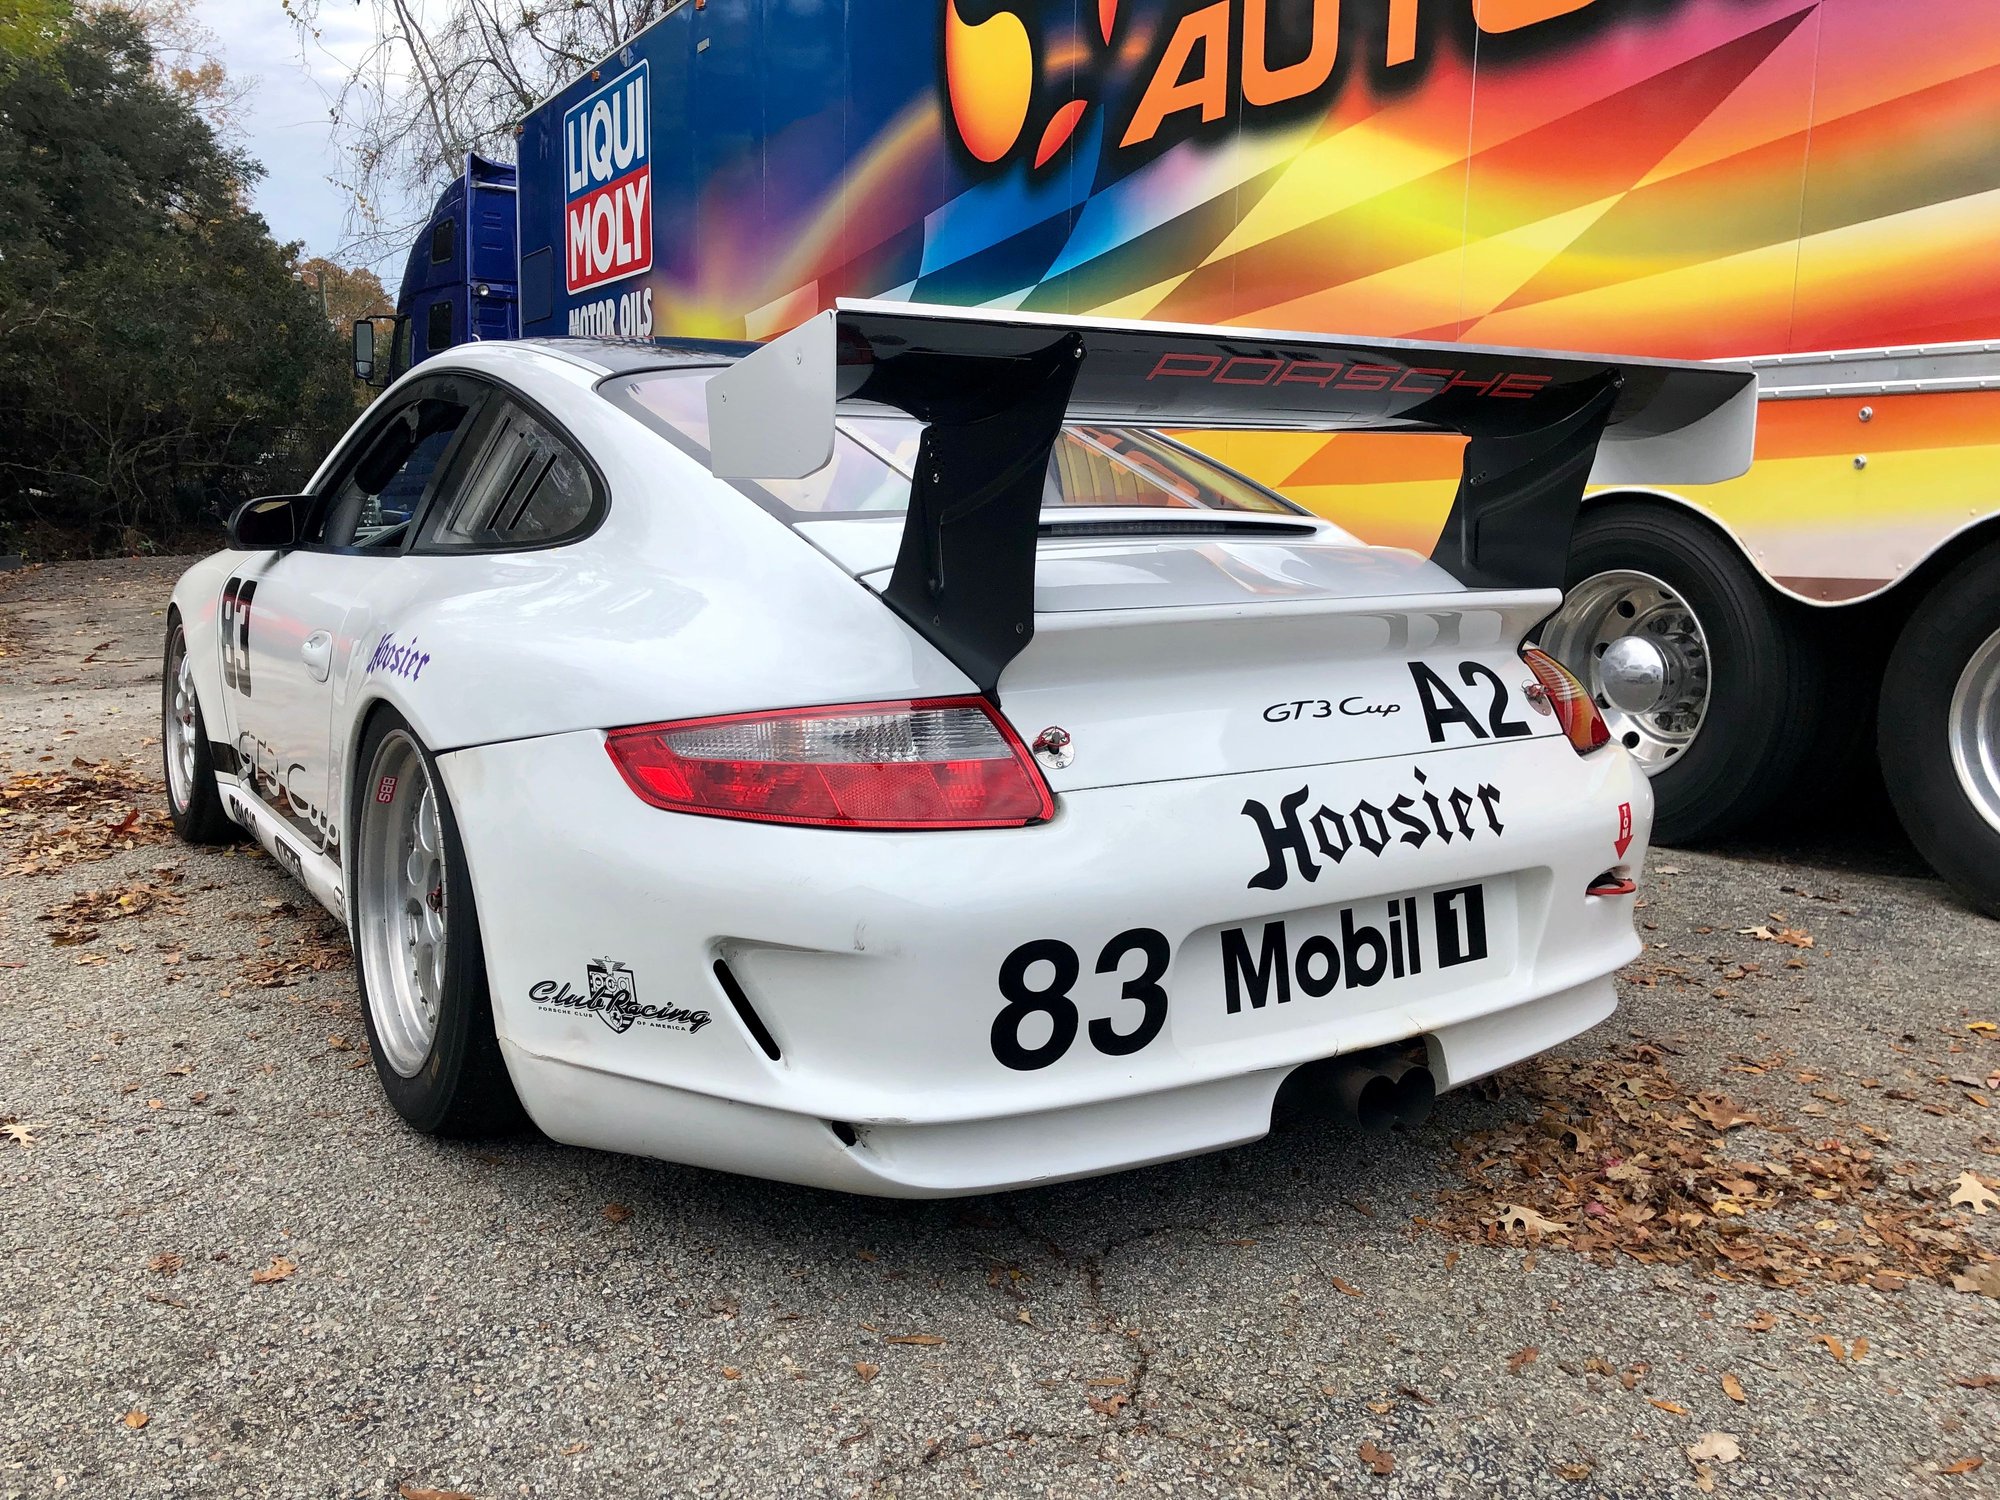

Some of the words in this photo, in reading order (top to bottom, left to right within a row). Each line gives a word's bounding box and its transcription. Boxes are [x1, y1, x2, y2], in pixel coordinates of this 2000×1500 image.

[567, 74, 645, 194] LIQUI
[569, 174, 649, 282] MOLY
[568, 298, 616, 336] MOTOR
[620, 287, 653, 337] OILS
[1146, 352, 1552, 399] PORSCHE
[221, 576, 258, 698] 83
[366, 631, 431, 682] Hoosier
[1262, 699, 1333, 723] GT3
[1338, 696, 1400, 717] Cup
[1407, 660, 1533, 743] A2
[378, 776, 396, 803] BBS
[1241, 766, 1505, 890] Hoosier
[1621, 805, 1630, 839] TOW
[1220, 896, 1421, 1015] Mobil
[528, 980, 608, 1011] Club
[604, 988, 713, 1035] Racing
[538, 1006, 571, 1015] PORSCHE
[574, 1011, 593, 1019] CLUB
[649, 1022, 686, 1031] AMERICA
[990, 927, 1171, 1072] 83
